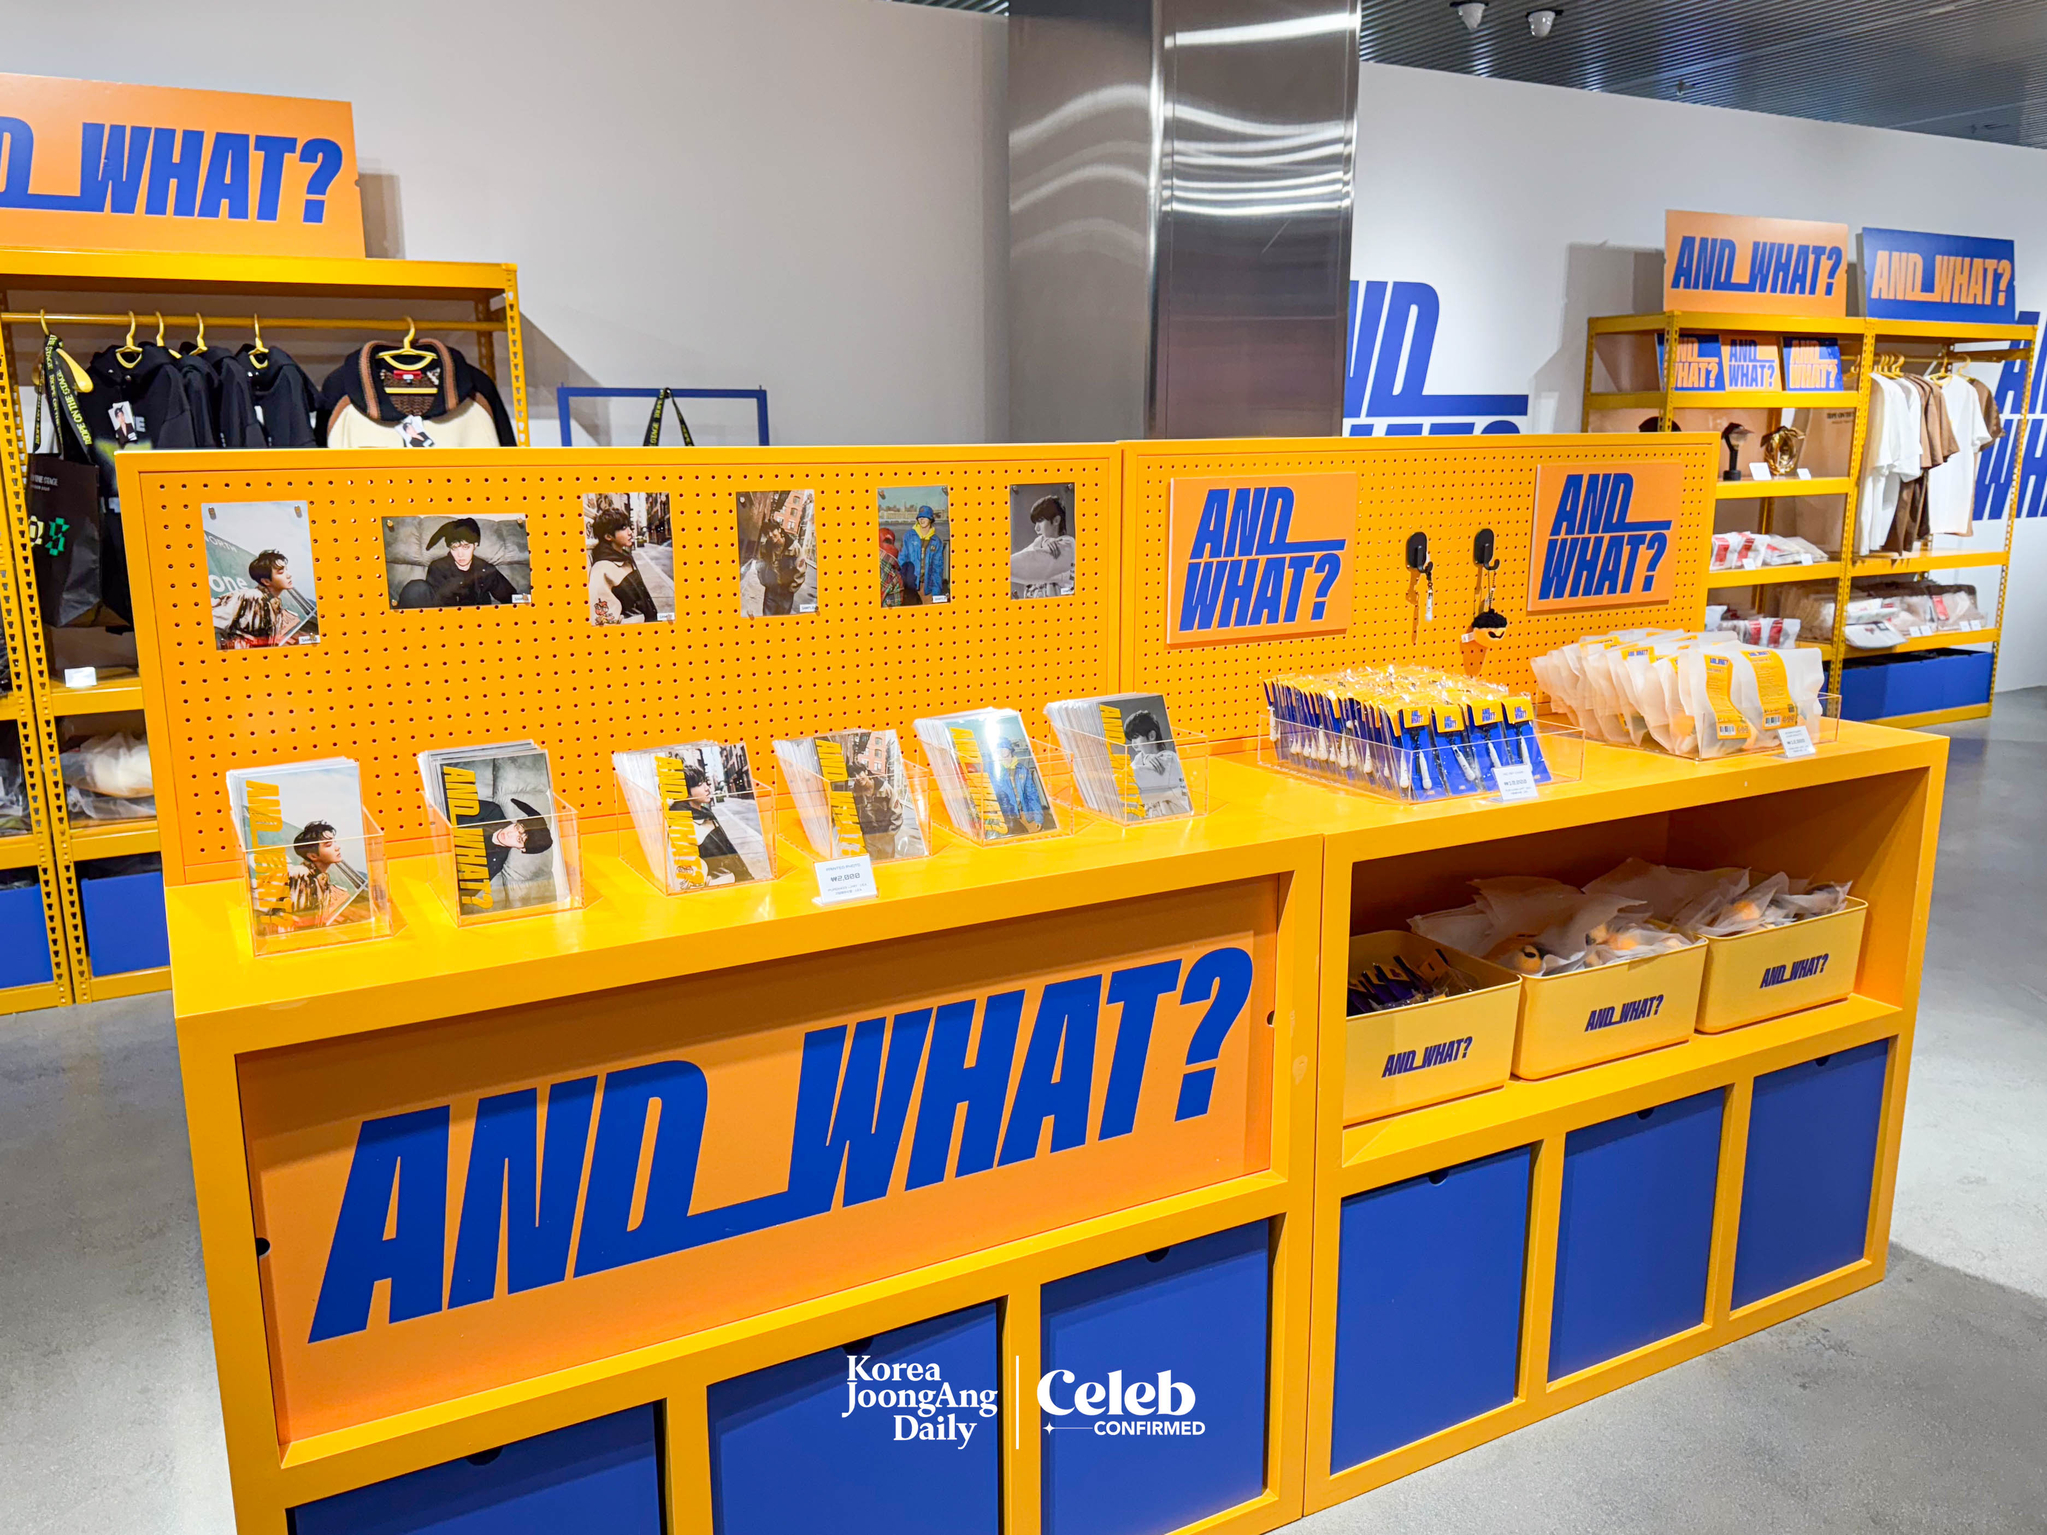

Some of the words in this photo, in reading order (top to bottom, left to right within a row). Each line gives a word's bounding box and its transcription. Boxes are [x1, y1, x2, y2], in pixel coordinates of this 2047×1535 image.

[80, 122, 343, 223] WHAT?
[1671, 236, 1745, 291] AND
[1749, 241, 1843, 296] WHAT?
[1871, 250, 1930, 301] AND
[1934, 255, 2012, 306] WHAT?
[1729, 339, 1775, 363] AND
[1789, 340, 1838, 364] AND
[1729, 364, 1776, 388] WHAT?
[1789, 363, 1838, 389] WHAT?
[1190, 486, 1346, 559] AND
[1550, 472, 1672, 536] AND
[1538, 532, 1667, 600] WHAT?
[1178, 552, 1341, 631] WHAT?
[949, 727, 983, 768] AND
[1099, 704, 1127, 747] AND
[654, 756, 689, 804] AND
[815, 739, 849, 786] AND
[443, 766, 480, 822] AND
[453, 828, 494, 909] WHAT?
[1760, 969, 1792, 989] AND
[1792, 953, 1830, 980] WHAT?
[1584, 1010, 1618, 1033] AND
[1618, 994, 1665, 1024] WHAT?
[1381, 1052, 1420, 1078] AND
[1421, 1036, 1473, 1068] WHAT?
[308, 1059, 790, 1344] AND
[790, 946, 1253, 1212] WHAT?
